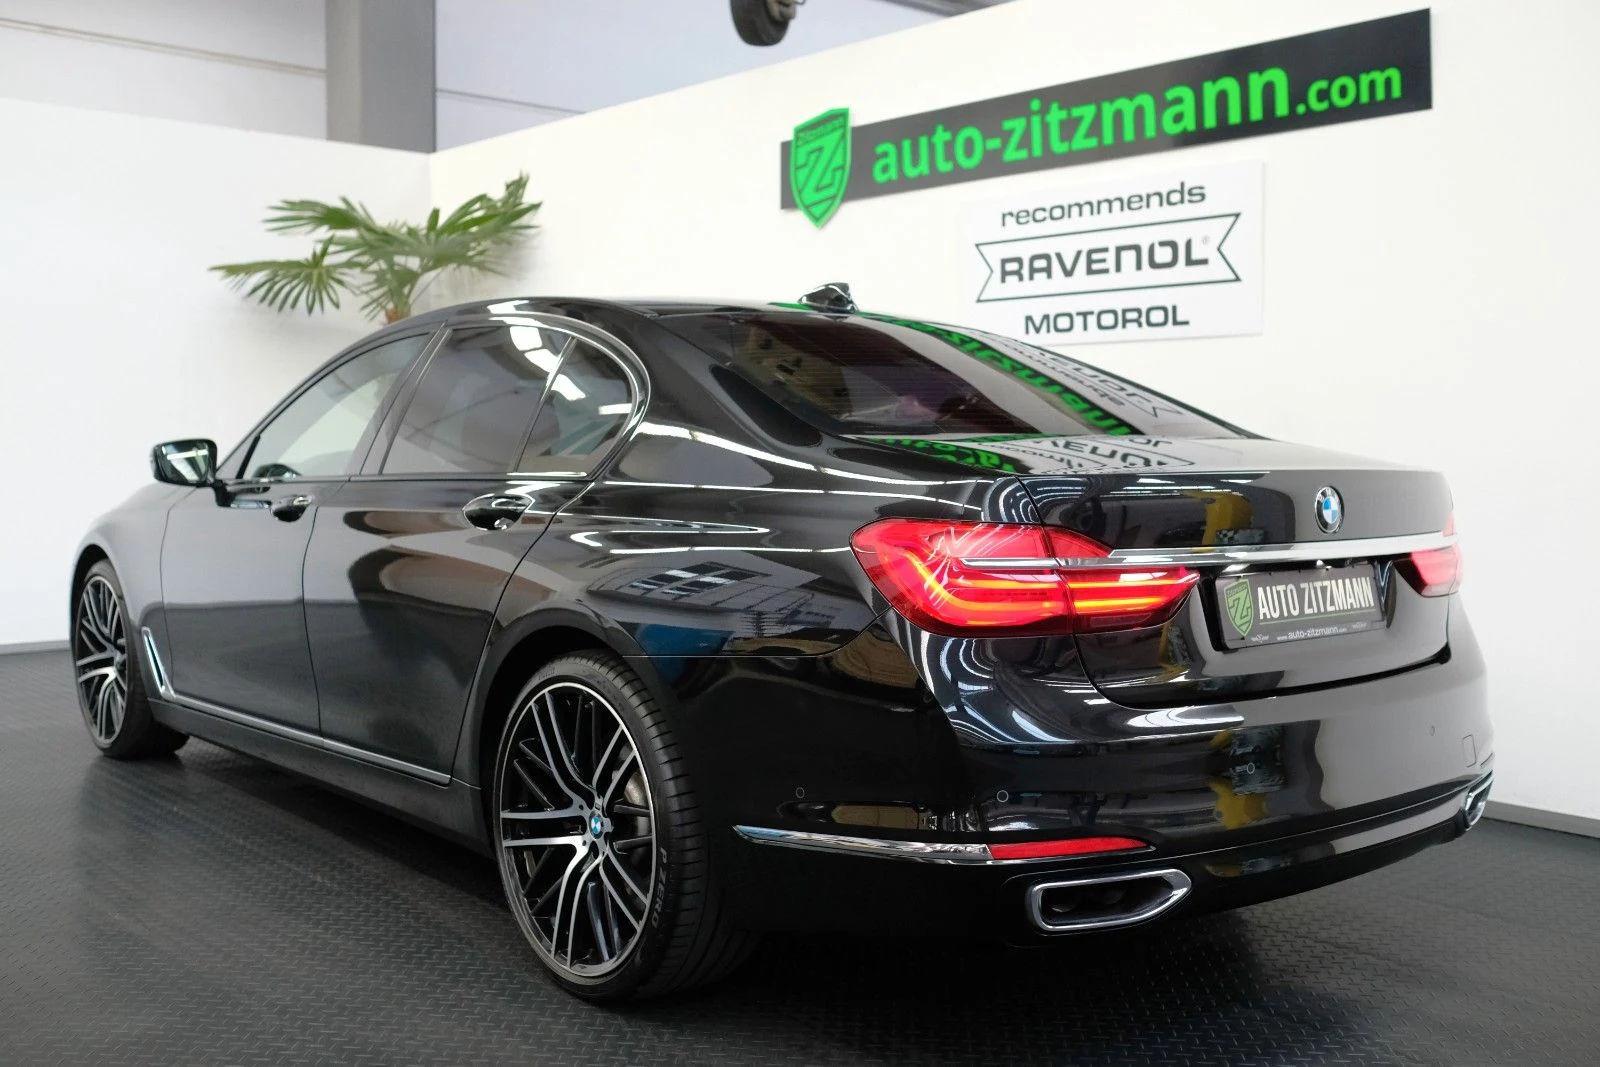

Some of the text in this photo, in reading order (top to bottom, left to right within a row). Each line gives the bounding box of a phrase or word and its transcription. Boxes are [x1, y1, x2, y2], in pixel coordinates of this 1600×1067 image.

[872, 65, 1401, 183] auto-zitzmann.com
[1001, 181, 1207, 227] recommends
[1000, 238, 1209, 284] RAVENOL
[1024, 304, 1190, 335] MOTOROL
[1257, 576, 1375, 620] AUTO ZITZMANN
[651, 846, 668, 929] P ZERO
